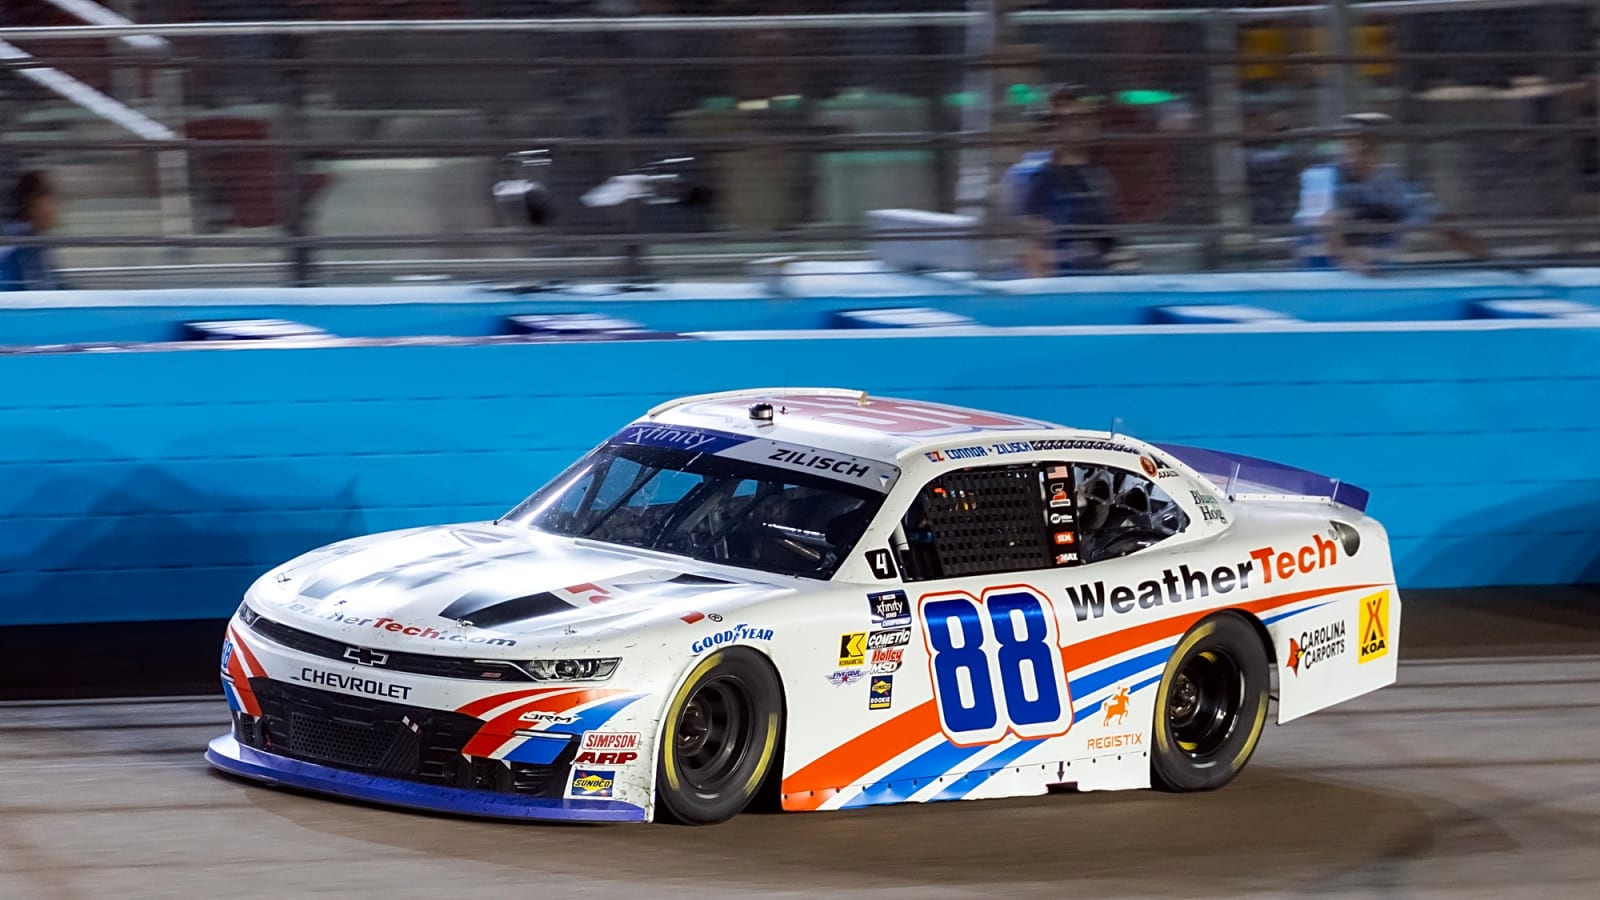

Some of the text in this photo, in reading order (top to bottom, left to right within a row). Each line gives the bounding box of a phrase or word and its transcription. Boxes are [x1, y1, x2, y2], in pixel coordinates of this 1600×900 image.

[628, 427, 716, 450] xfinity
[944, 446, 986, 460] CONNOR
[992, 441, 1032, 455] ZILISCH
[768, 448, 872, 477] ZILISCH
[876, 552, 889, 575] 4
[1065, 534, 1337, 622] WeatherTech
[877, 600, 904, 617] xfinity
[868, 630, 911, 647] COMETIC
[1300, 620, 1346, 653] CAROLINA
[871, 649, 904, 664] Holley
[1304, 639, 1345, 669] CARPORTS
[1361, 640, 1386, 656] KOA
[870, 661, 898, 674] MSD
[923, 591, 1061, 733] 88
[301, 668, 413, 700] CHEVROLET
[586, 733, 637, 748] SIMPSON
[1087, 733, 1142, 750] REGISTIX
[574, 751, 638, 764] ARP
[573, 779, 610, 788] SUNOCO
